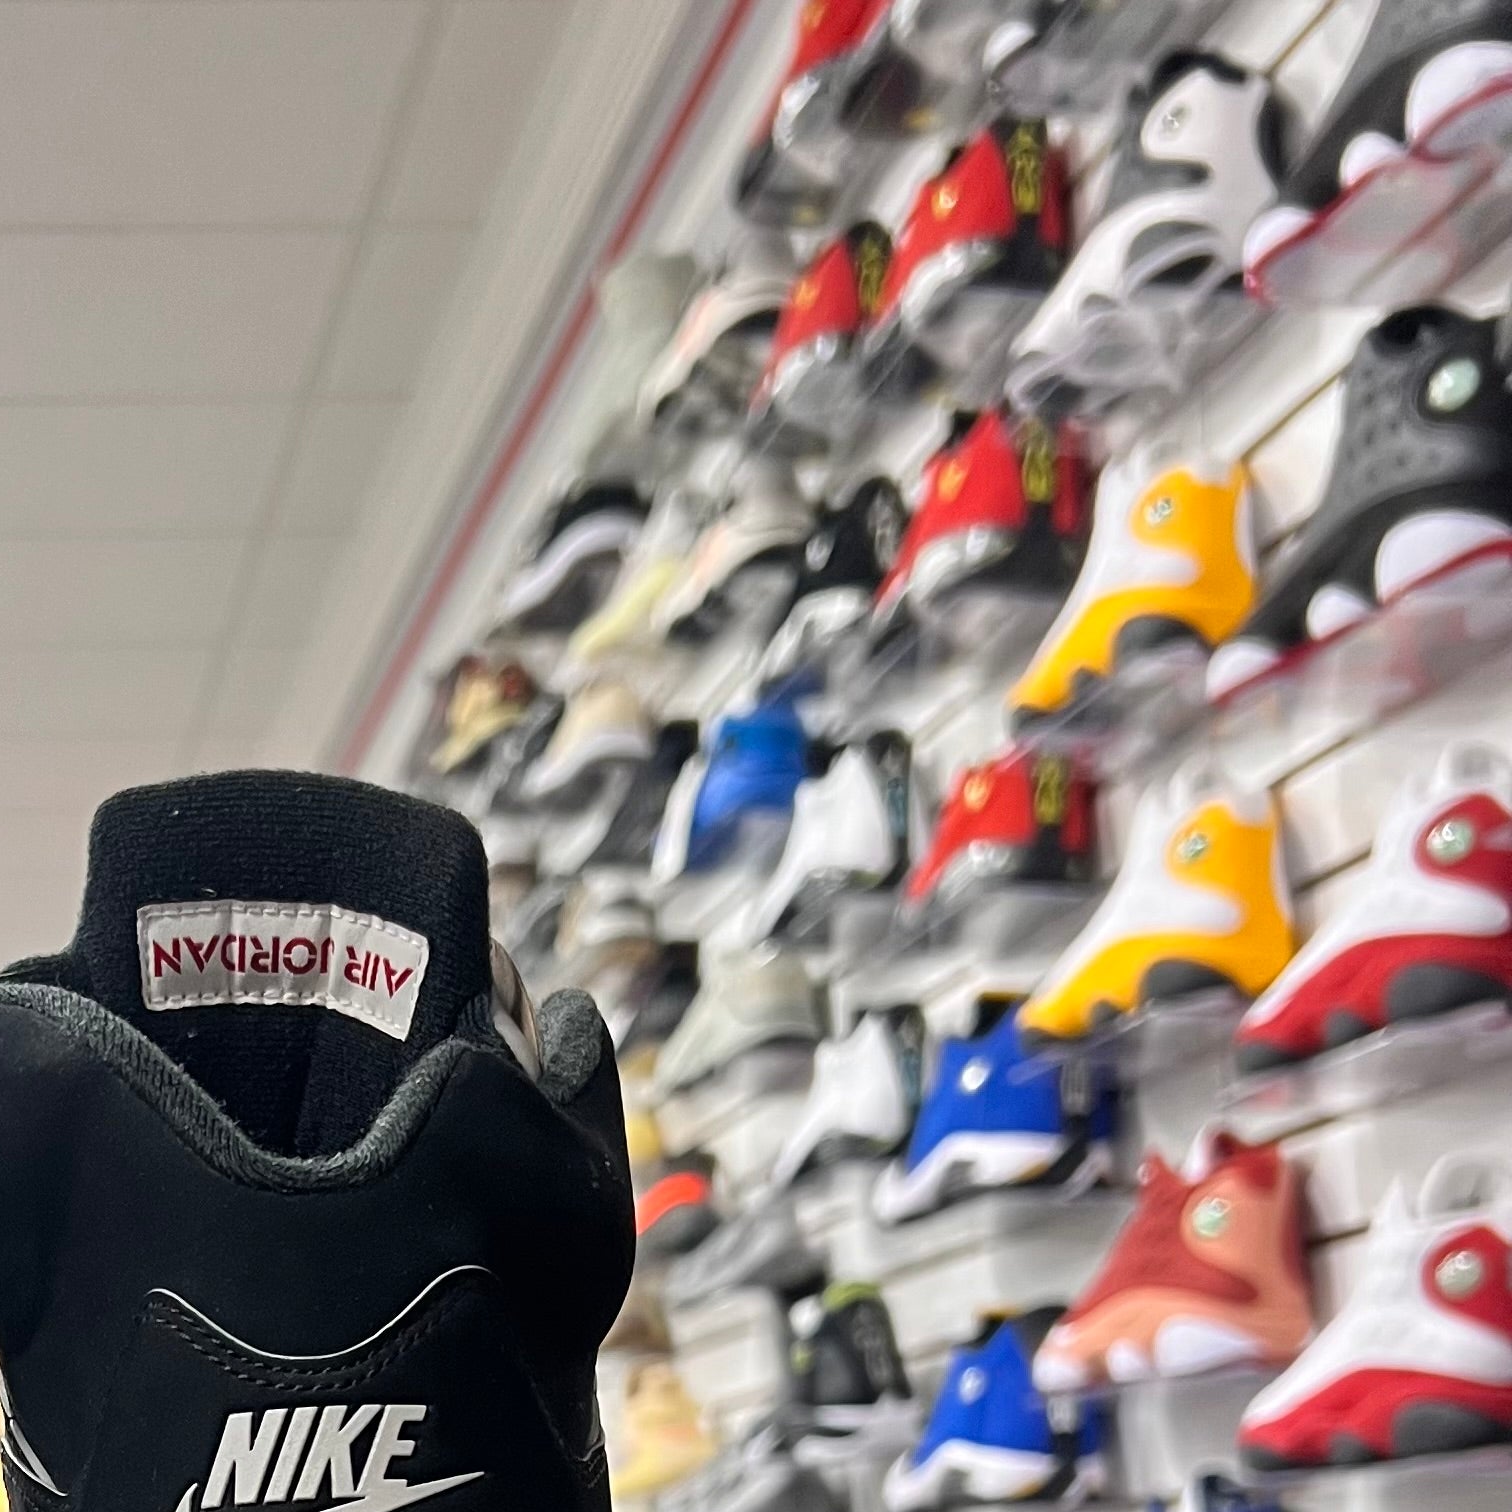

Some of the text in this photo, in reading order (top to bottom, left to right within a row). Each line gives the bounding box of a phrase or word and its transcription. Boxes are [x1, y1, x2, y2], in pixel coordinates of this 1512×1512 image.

[152, 934, 415, 999] AIR JORDAN
[200, 1404, 427, 1510] NIKE
